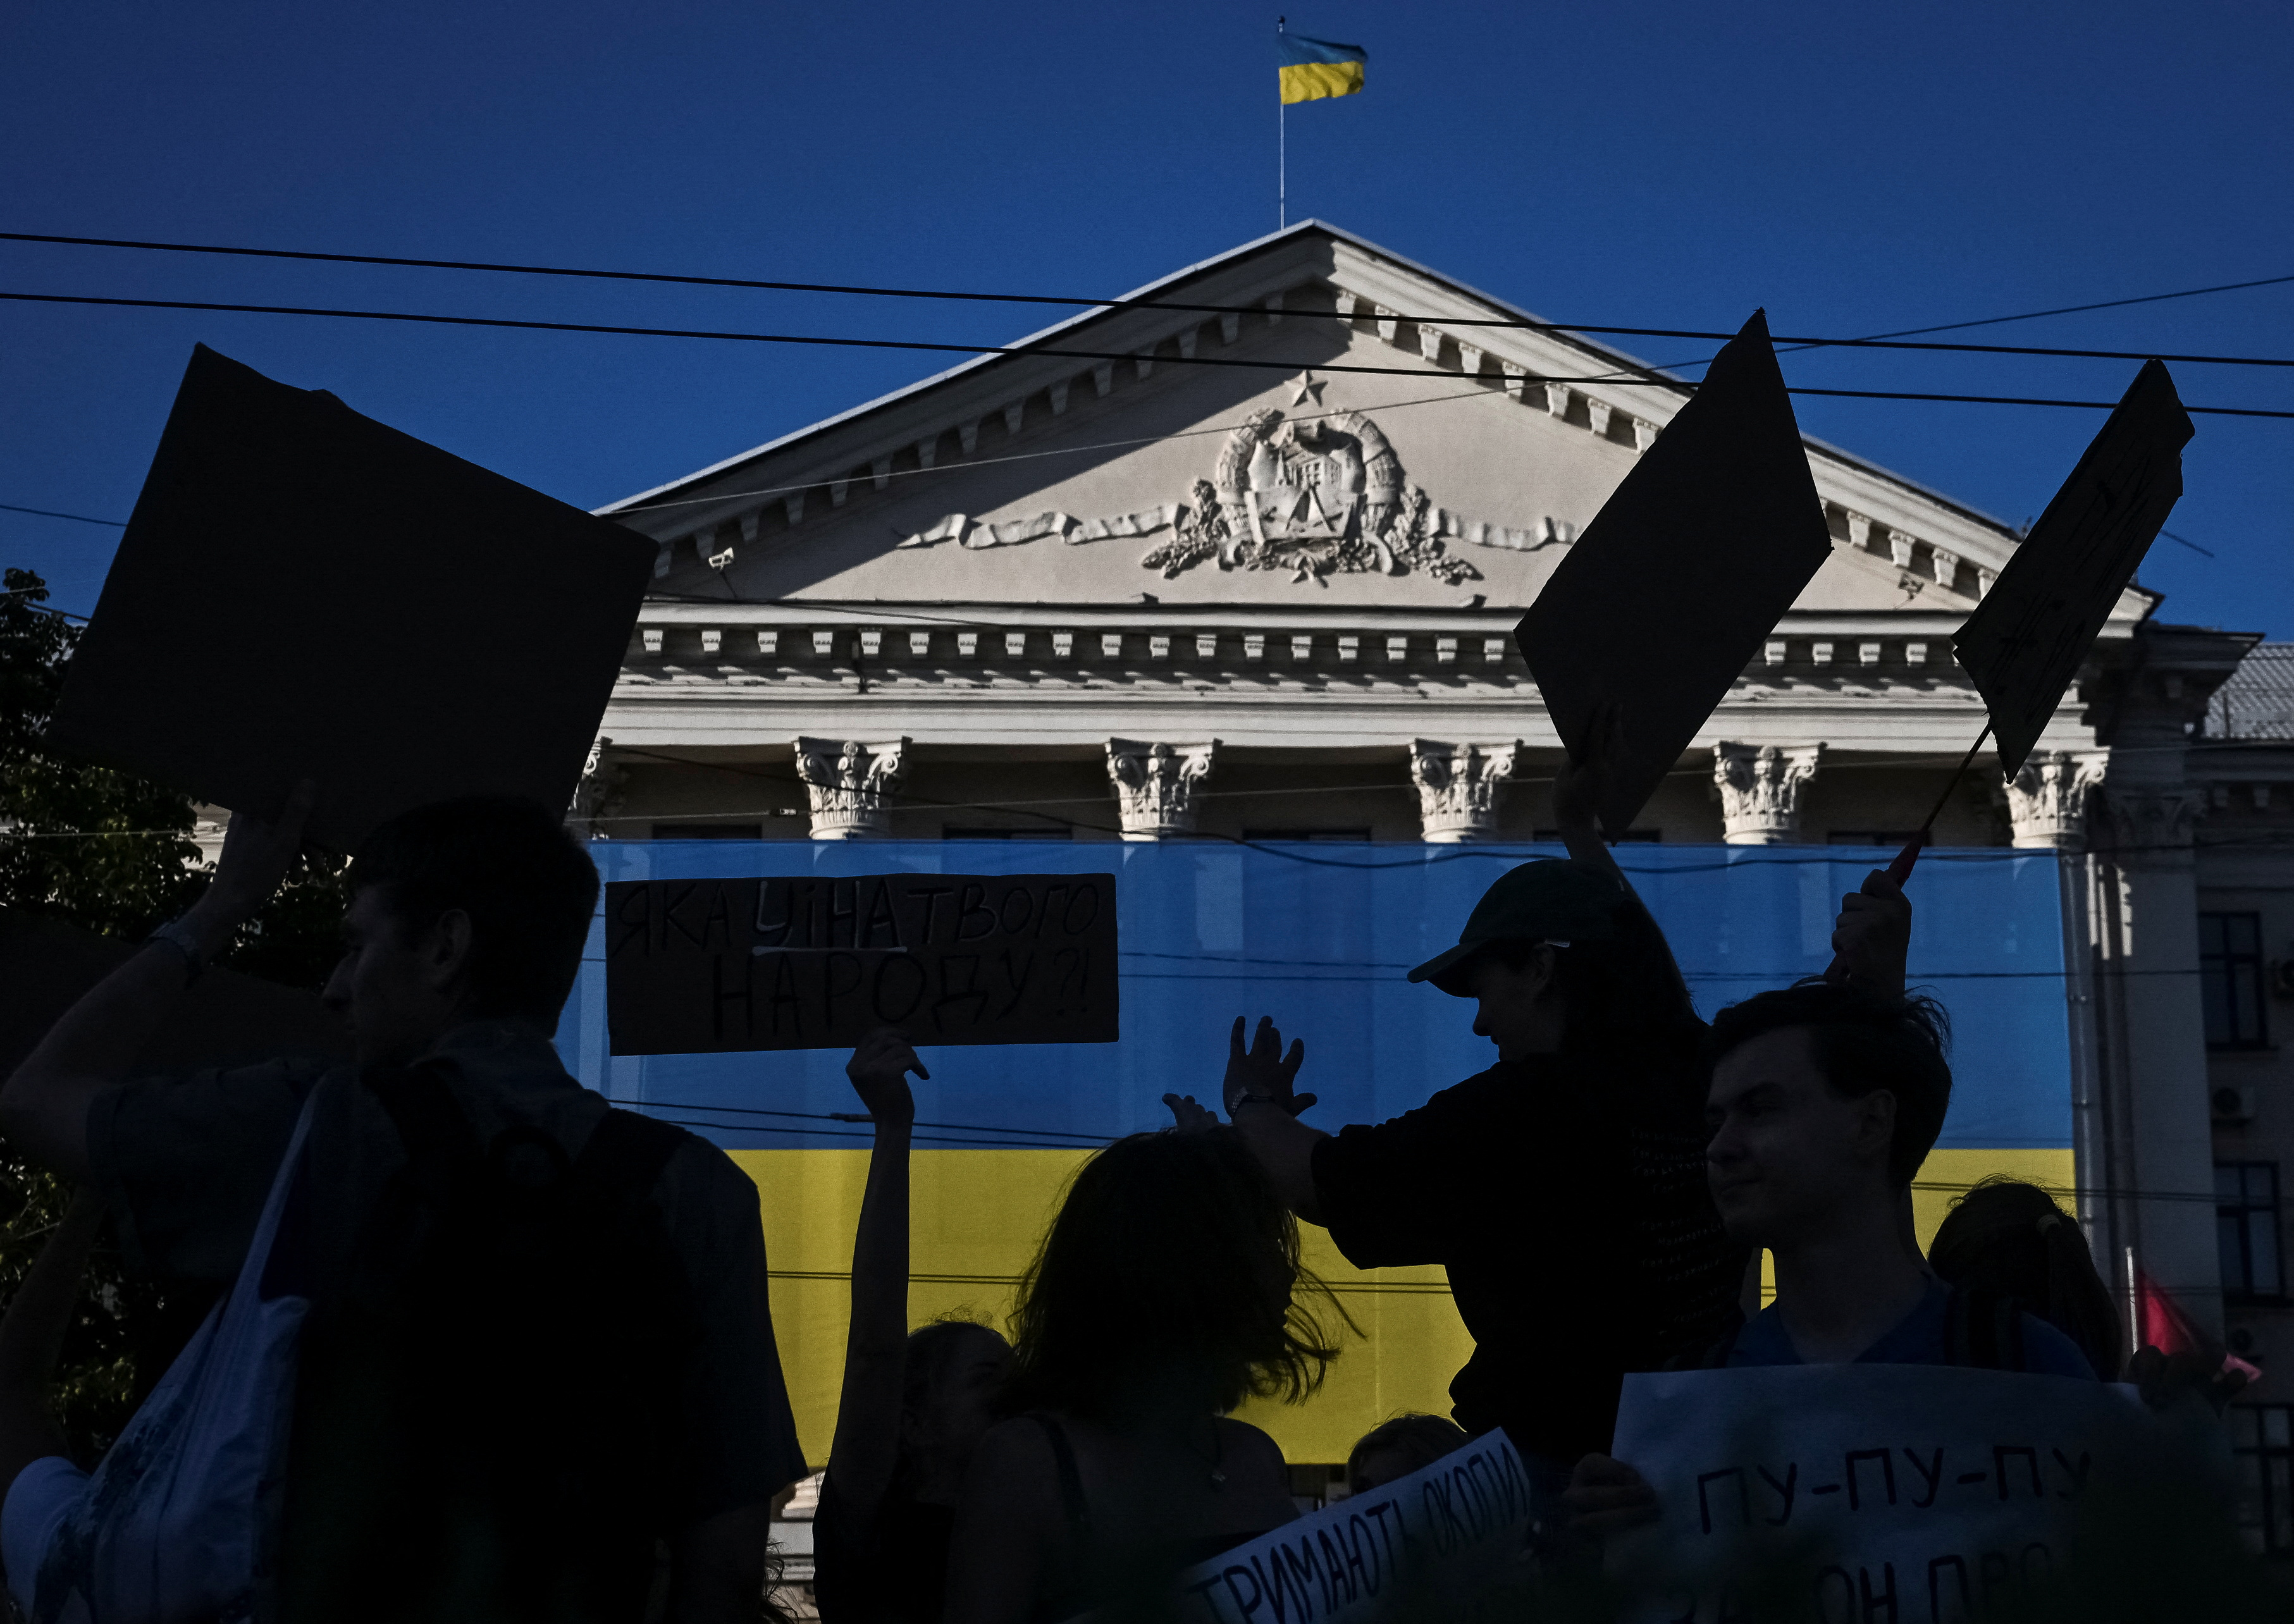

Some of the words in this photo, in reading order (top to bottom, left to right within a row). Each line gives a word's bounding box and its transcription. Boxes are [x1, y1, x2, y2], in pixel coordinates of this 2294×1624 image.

[611, 882, 732, 957] ЯКА
[907, 883, 1100, 945] ТВОГО
[1423, 1442, 1528, 1559] ОКОПИ
[1698, 1446, 2091, 1534] ПУ-ПУ-ПУ
